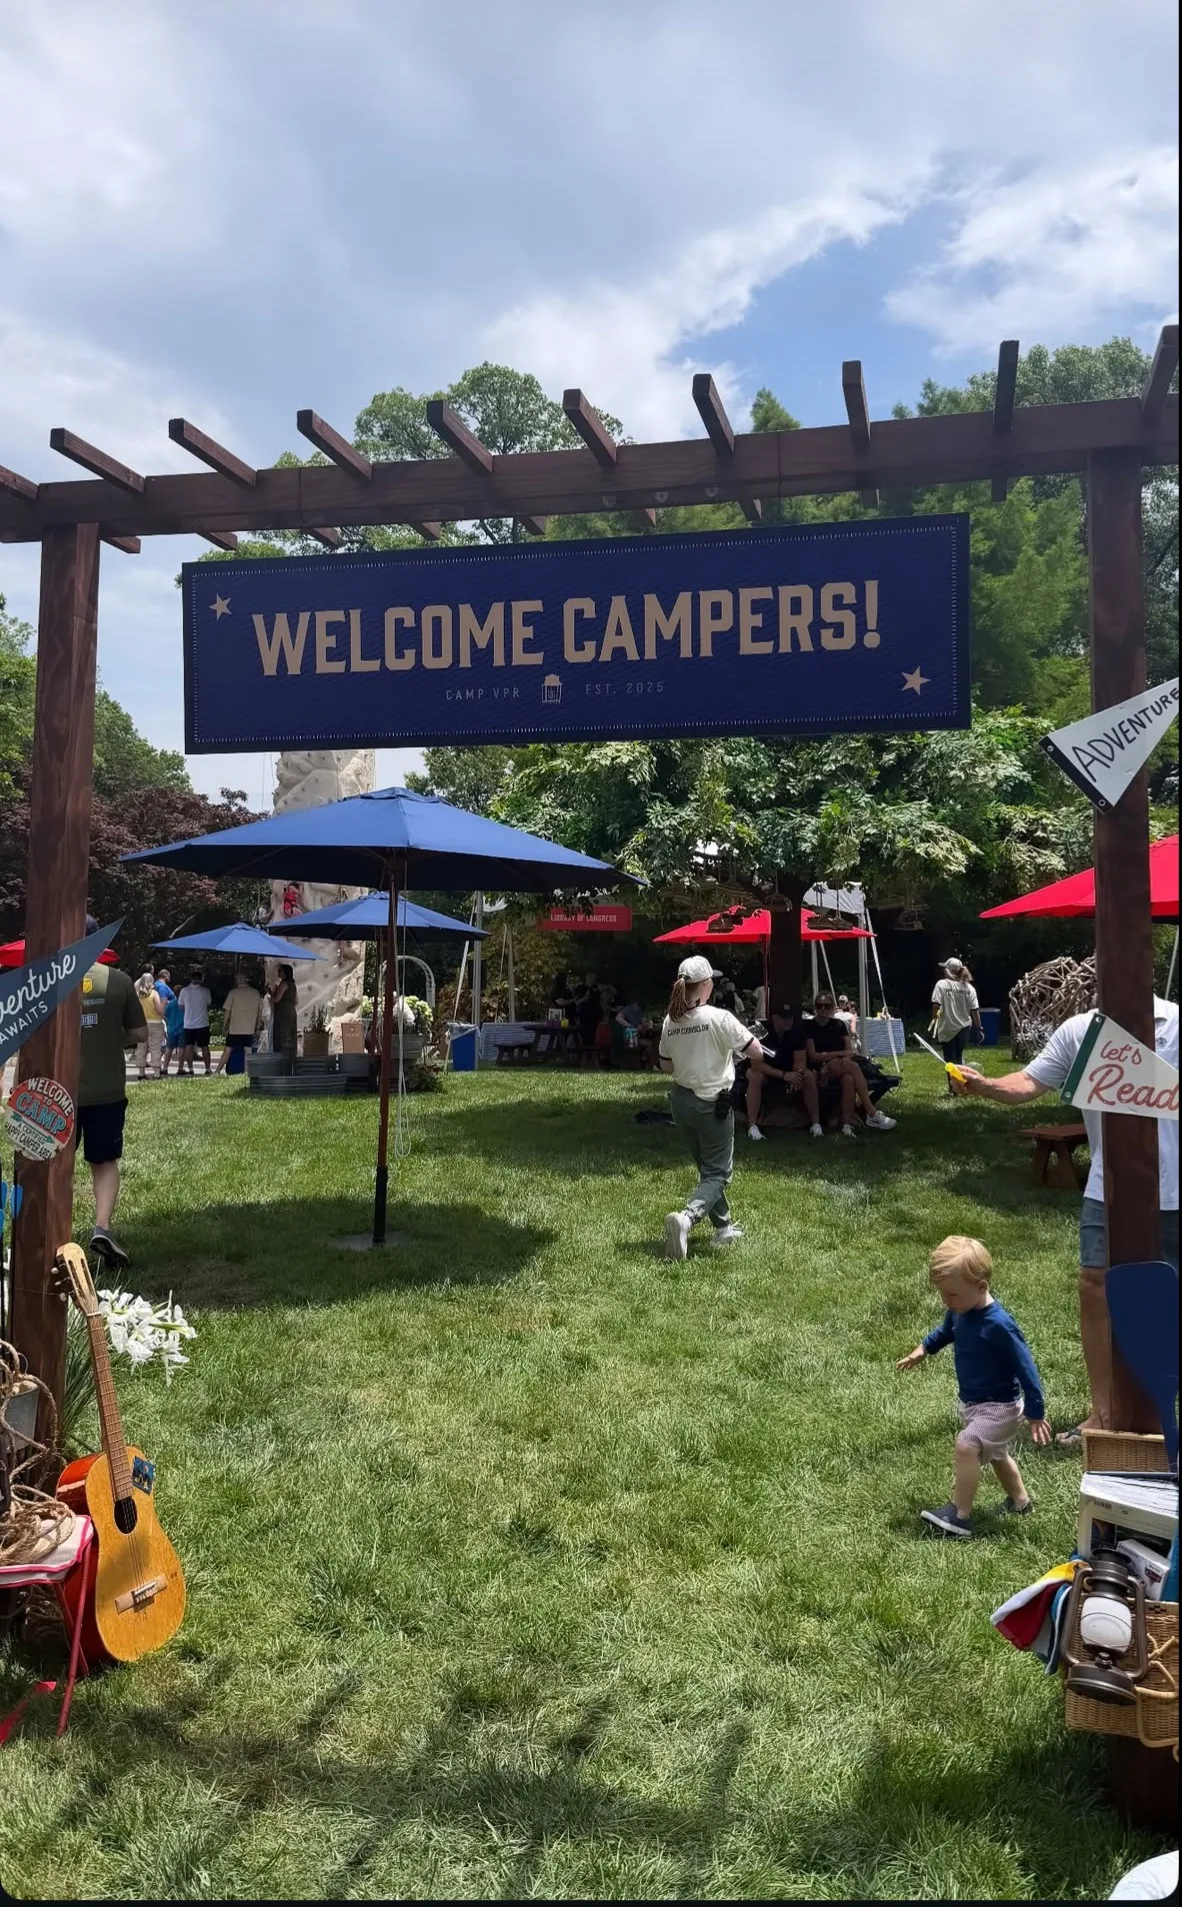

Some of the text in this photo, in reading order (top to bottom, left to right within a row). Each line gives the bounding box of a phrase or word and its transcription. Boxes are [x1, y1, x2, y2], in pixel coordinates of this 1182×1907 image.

[251, 579, 881, 676] WELCOME CAMPERS!
[446, 681, 664, 701] CAMP VPR EST. 2025
[1072, 687, 1180, 783] ADVENTURE
[0, 1000, 48, 1044] AWAITS
[667, 1026, 681, 1037] CAMP
[27, 1077, 74, 1117] WELCOME
[43, 1096, 53, 1106] TO
[1087, 1063, 1180, 1111] Read
[16, 1092, 68, 1135] CAMP
